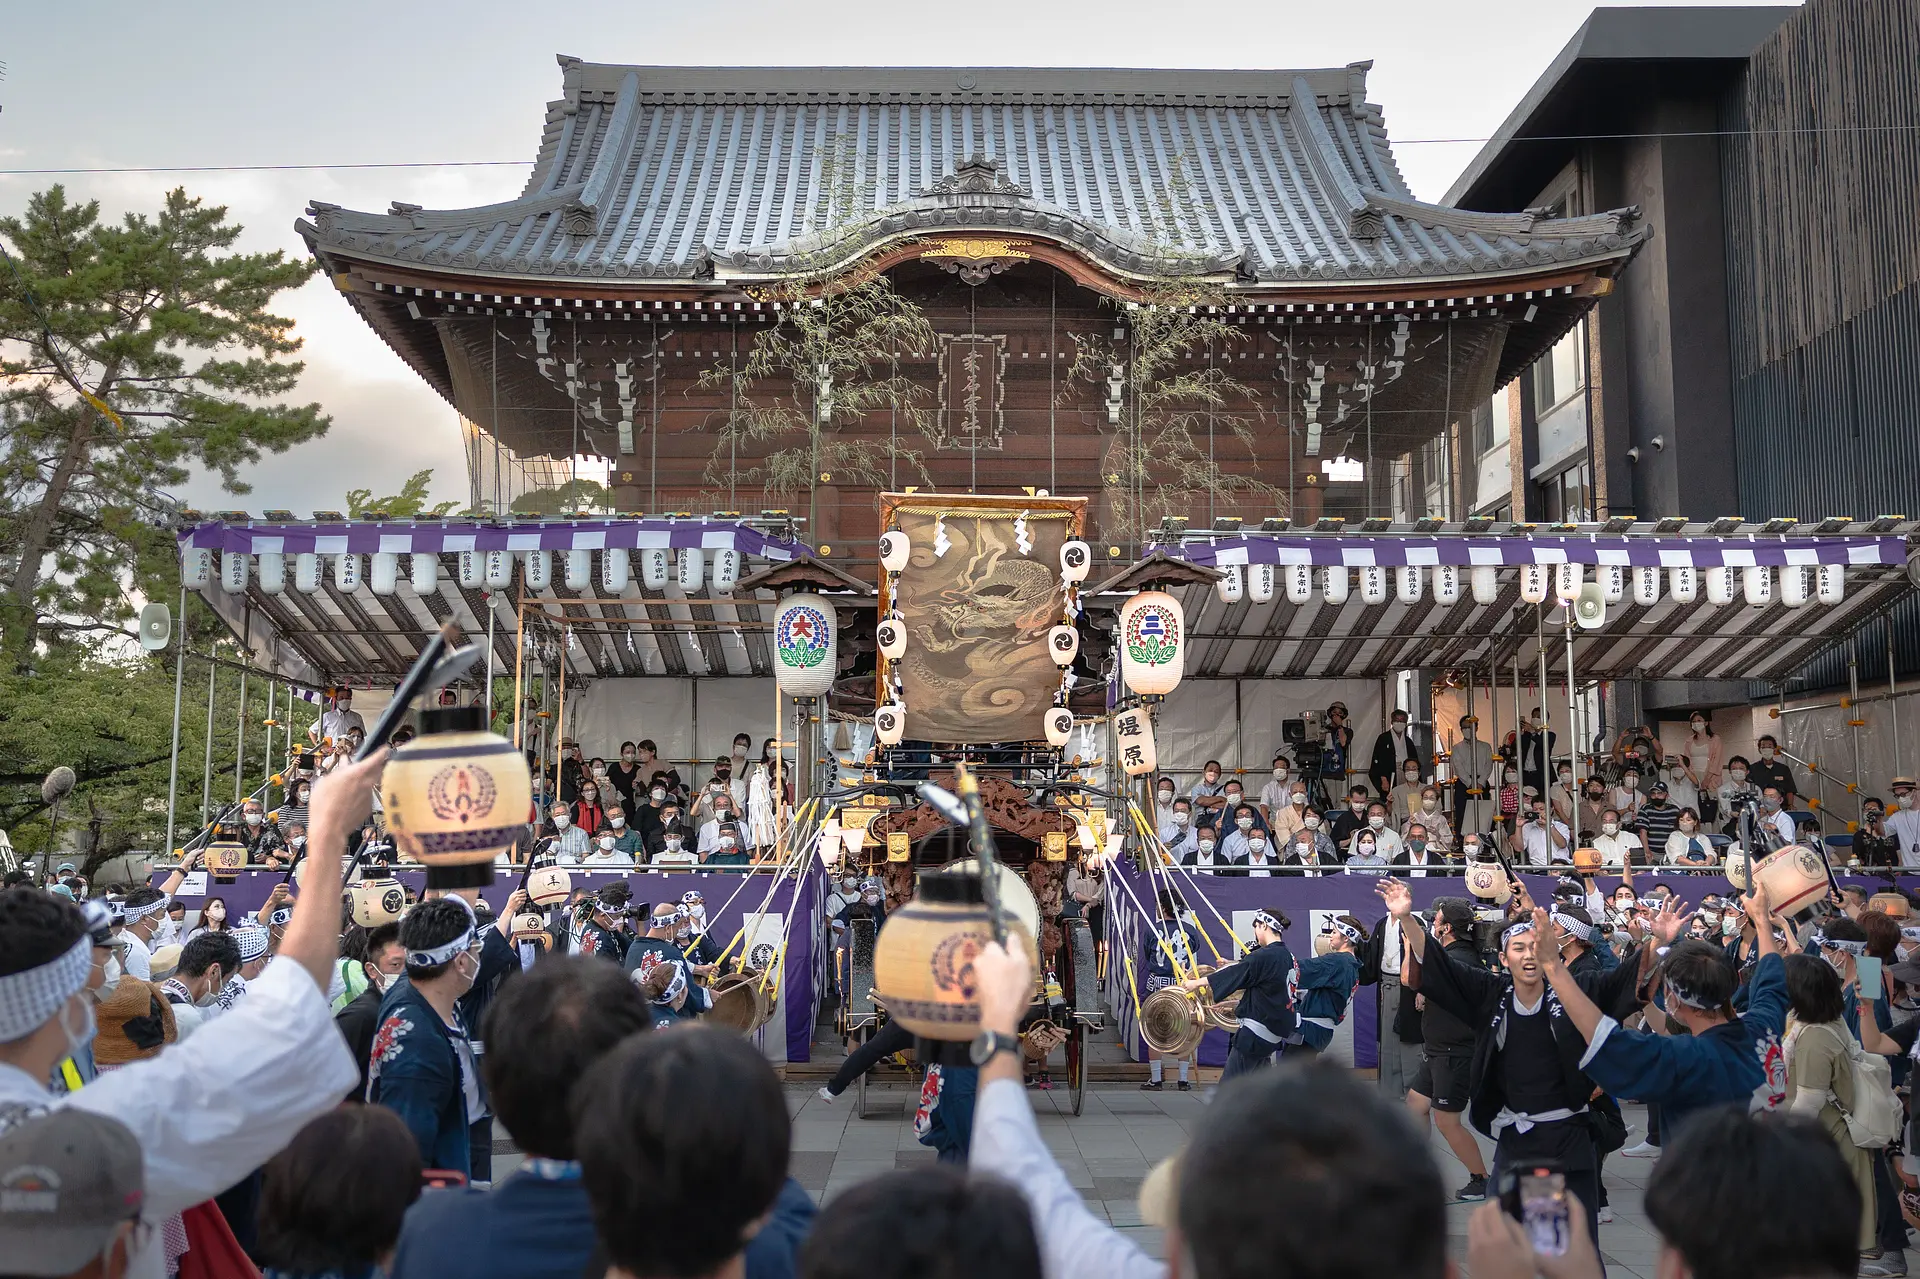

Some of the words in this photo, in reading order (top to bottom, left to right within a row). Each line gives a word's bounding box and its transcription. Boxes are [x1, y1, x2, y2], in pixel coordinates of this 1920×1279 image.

[961, 350, 983, 433] 桑名宗社
[197, 552, 209, 581] 桑名宗社
[343, 554, 355, 584] 桑名宗社
[653, 552, 664, 580] 桑名宗社
[721, 550, 734, 582] 桑名宗社
[1296, 564, 1307, 595] 桑名宗社
[1367, 565, 1379, 595] 桑名宗社
[1442, 565, 1453, 596] 桑名宗社
[1610, 565, 1620, 594] 桑名宗社
[1820, 566, 1830, 596] 桑名宗社
[792, 615, 813, 638] 大
[1140, 615, 1164, 635] 三
[1117, 715, 1145, 767] 堤原
